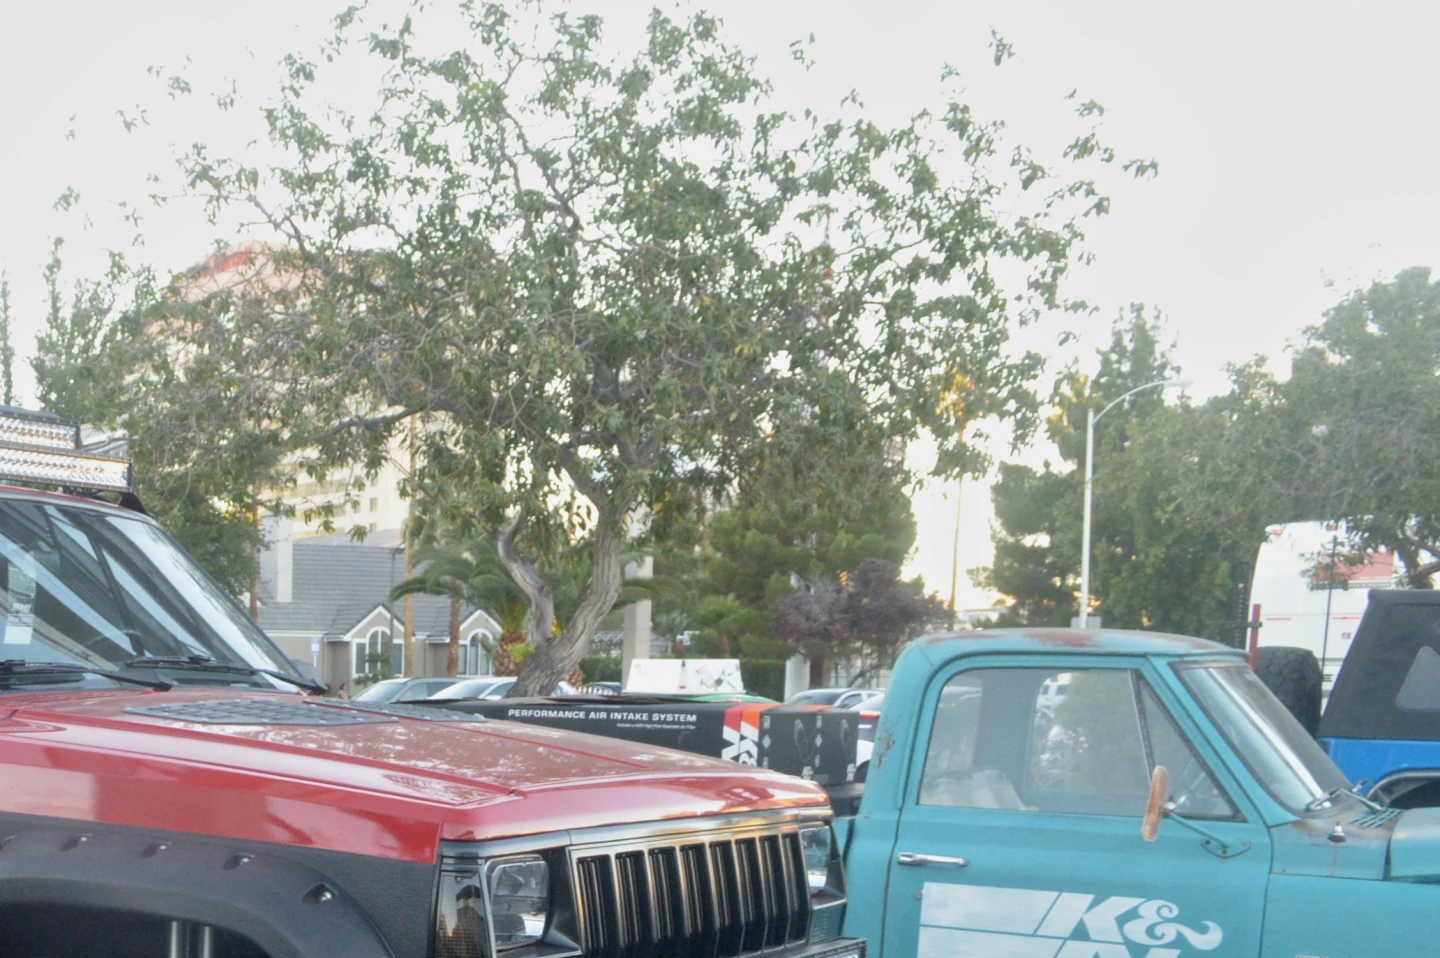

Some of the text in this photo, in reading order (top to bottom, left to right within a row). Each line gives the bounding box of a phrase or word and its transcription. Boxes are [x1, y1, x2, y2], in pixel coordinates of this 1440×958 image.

[508, 709, 697, 723] PERFORMANCE AIR INTAKE SYSTEM
